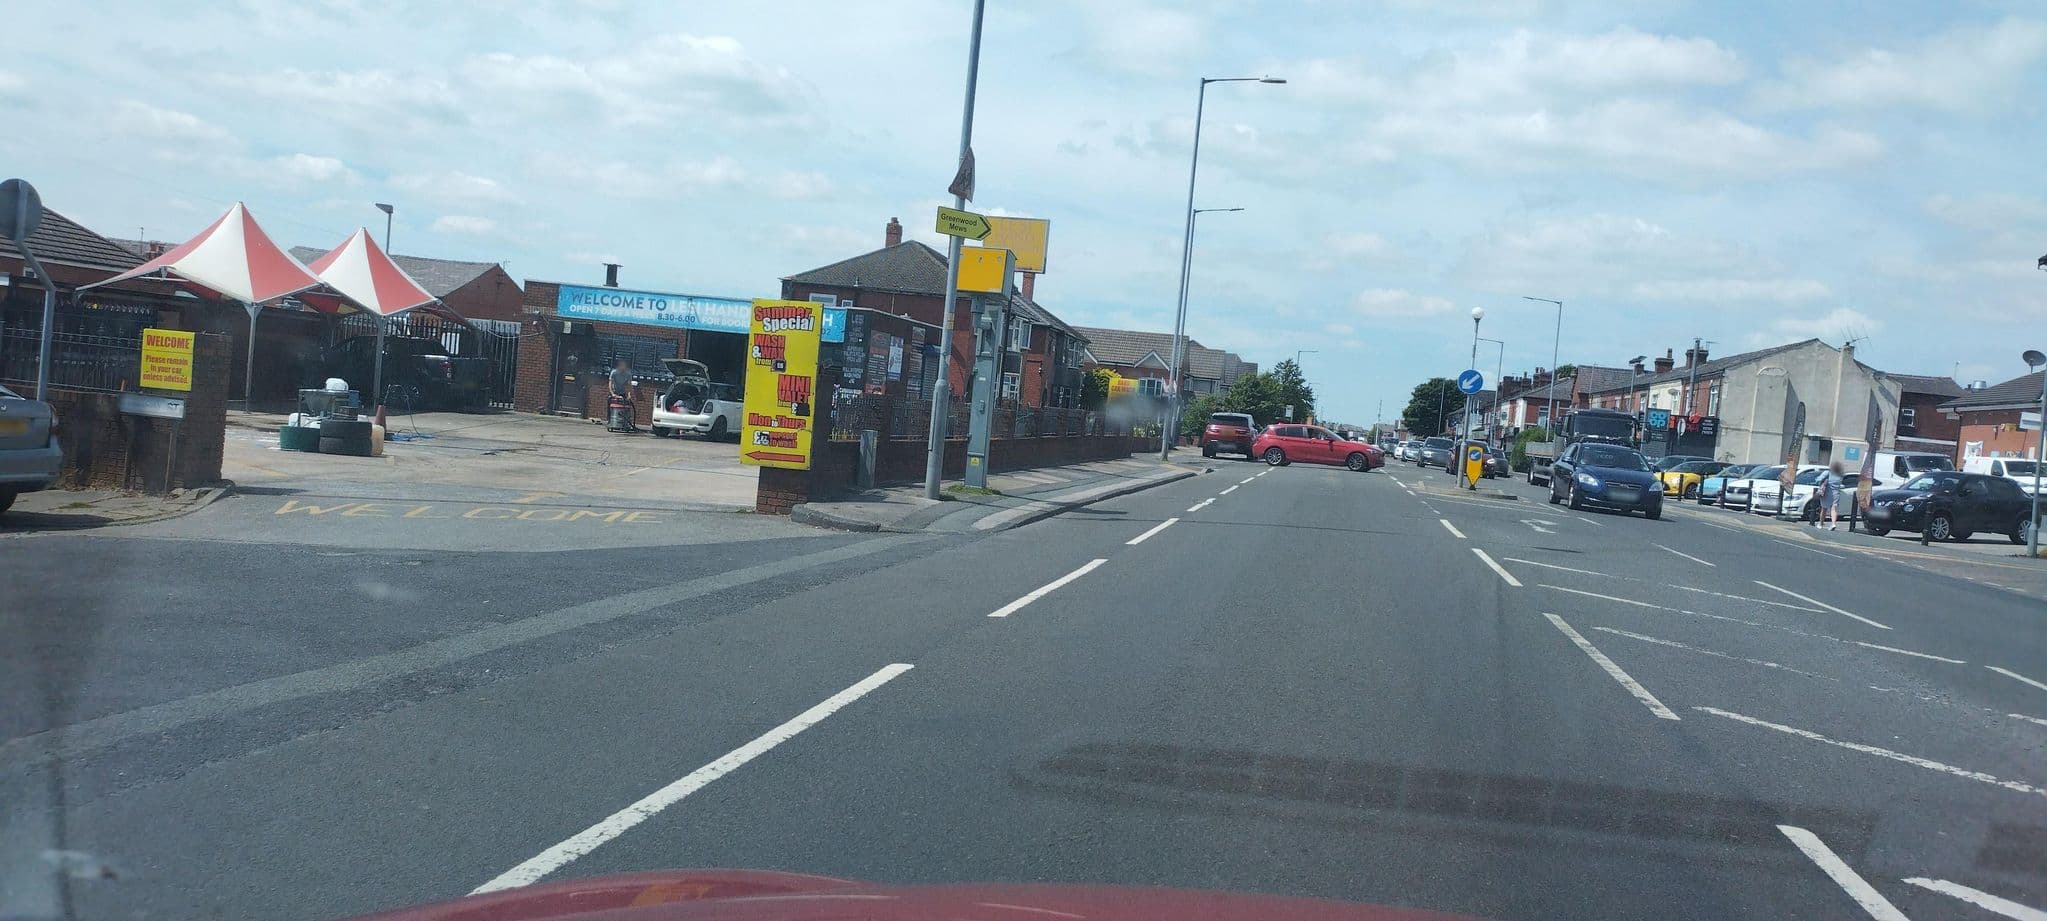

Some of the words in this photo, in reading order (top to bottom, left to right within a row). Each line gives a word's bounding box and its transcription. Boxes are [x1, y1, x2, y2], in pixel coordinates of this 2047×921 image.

[941, 213, 978, 227] Greenwood
[949, 223, 967, 233] Mews
[569, 304, 593, 314] OPEN
[572, 291, 644, 310] WELCOME
[648, 299, 667, 312] TO
[754, 306, 812, 321] Summer
[763, 315, 816, 333] Special
[146, 334, 190, 350] WELCOME
[754, 333, 786, 348] WASH
[146, 354, 166, 364] Please
[166, 356, 189, 366] remain
[143, 372, 163, 381] unless
[157, 365, 171, 374] your
[778, 374, 811, 394] MINI
[778, 390, 809, 404] VALET
[748, 412, 772, 427] Mon
[776, 415, 806, 429] Thurs
[273, 500, 663, 524] WELCOME
